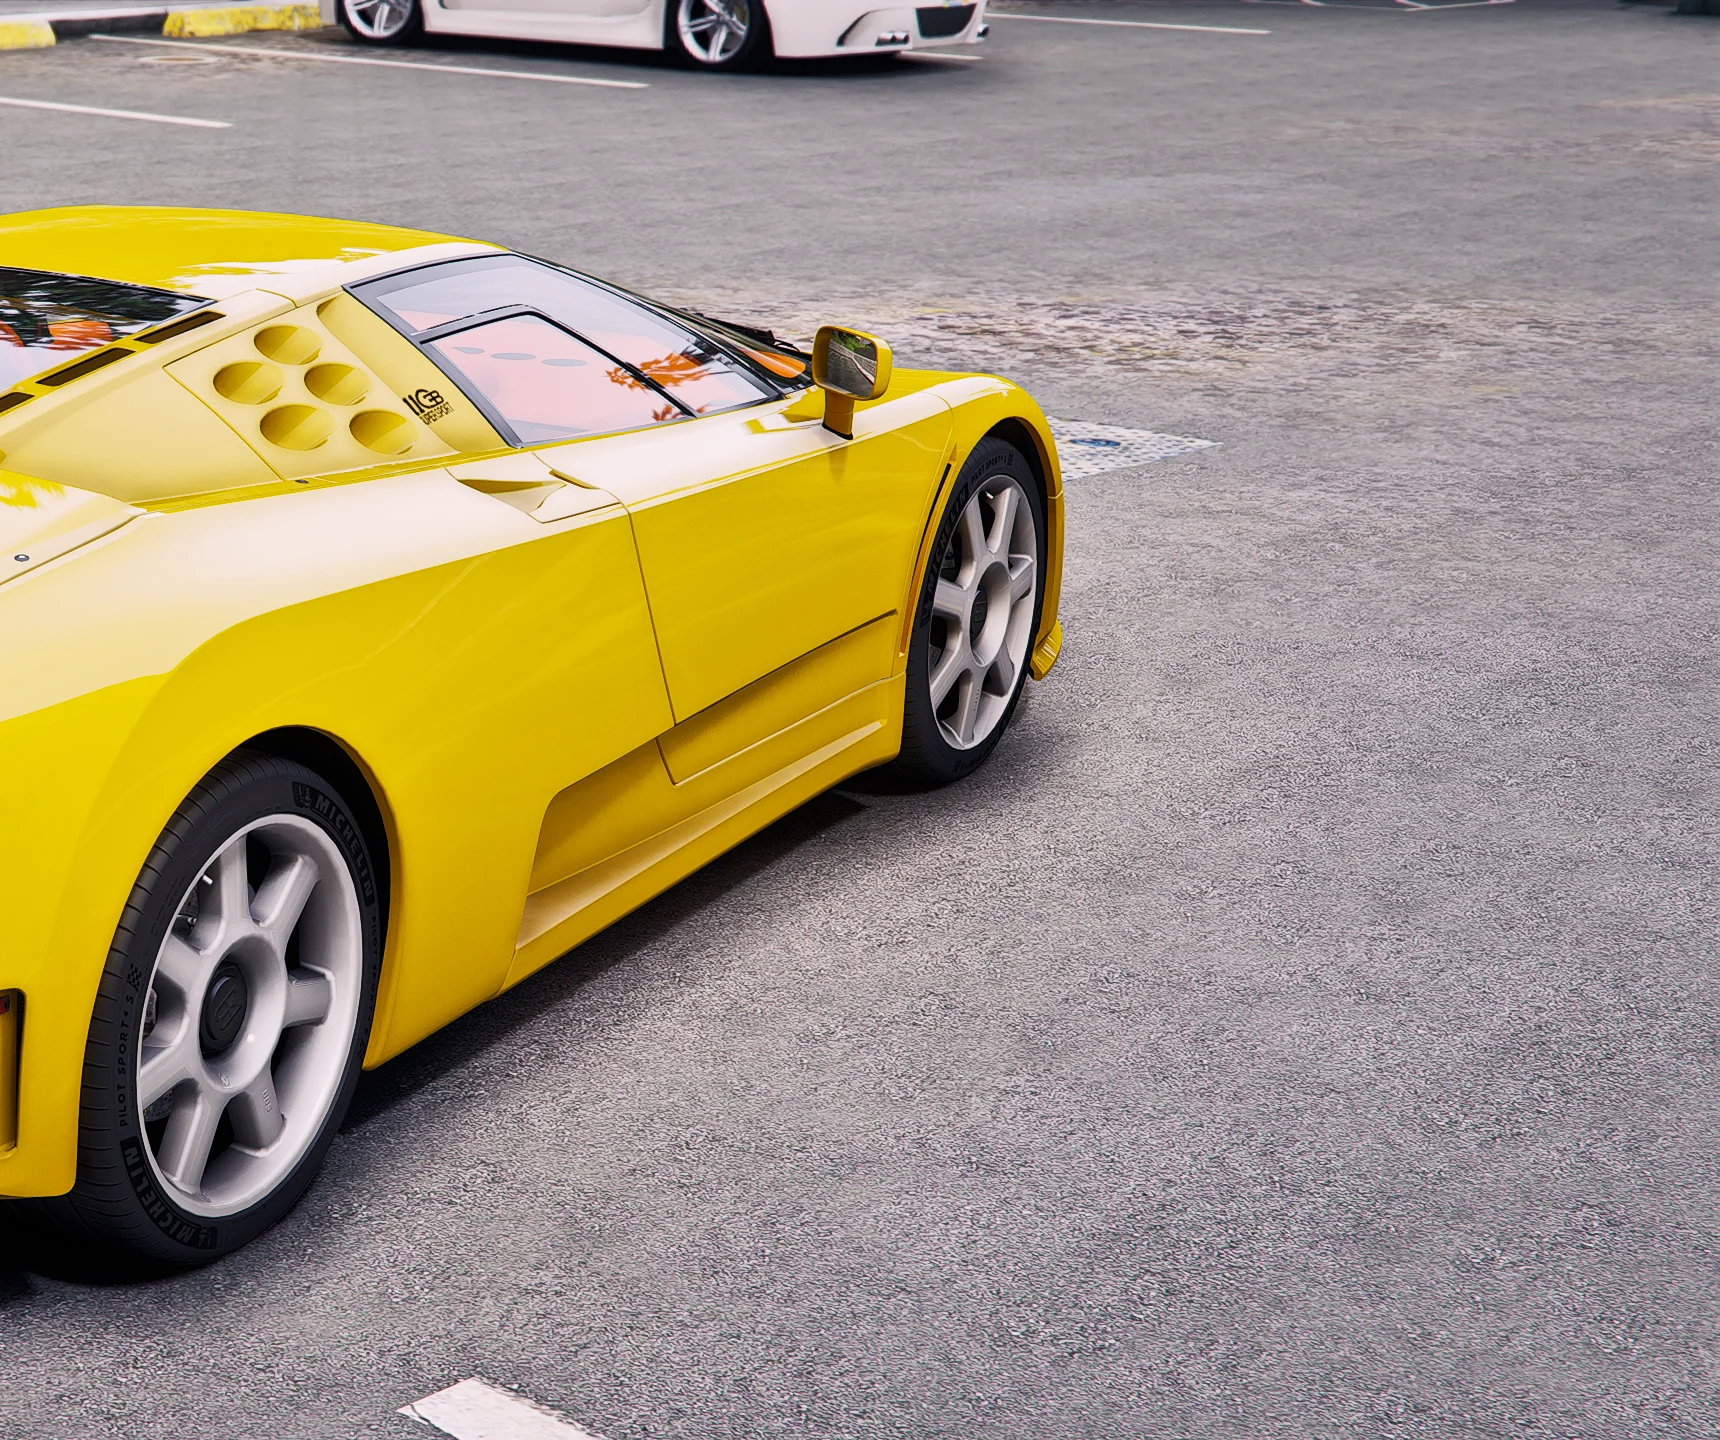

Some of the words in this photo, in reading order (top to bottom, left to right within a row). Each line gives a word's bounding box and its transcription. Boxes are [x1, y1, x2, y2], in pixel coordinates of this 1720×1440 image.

[315, 794, 374, 898] MICHELIN
[126, 994, 134, 1005] S
[117, 1021, 129, 1075] SPORT
[116, 1083, 129, 1127] PILOT
[124, 1146, 196, 1243] MICHELIN
